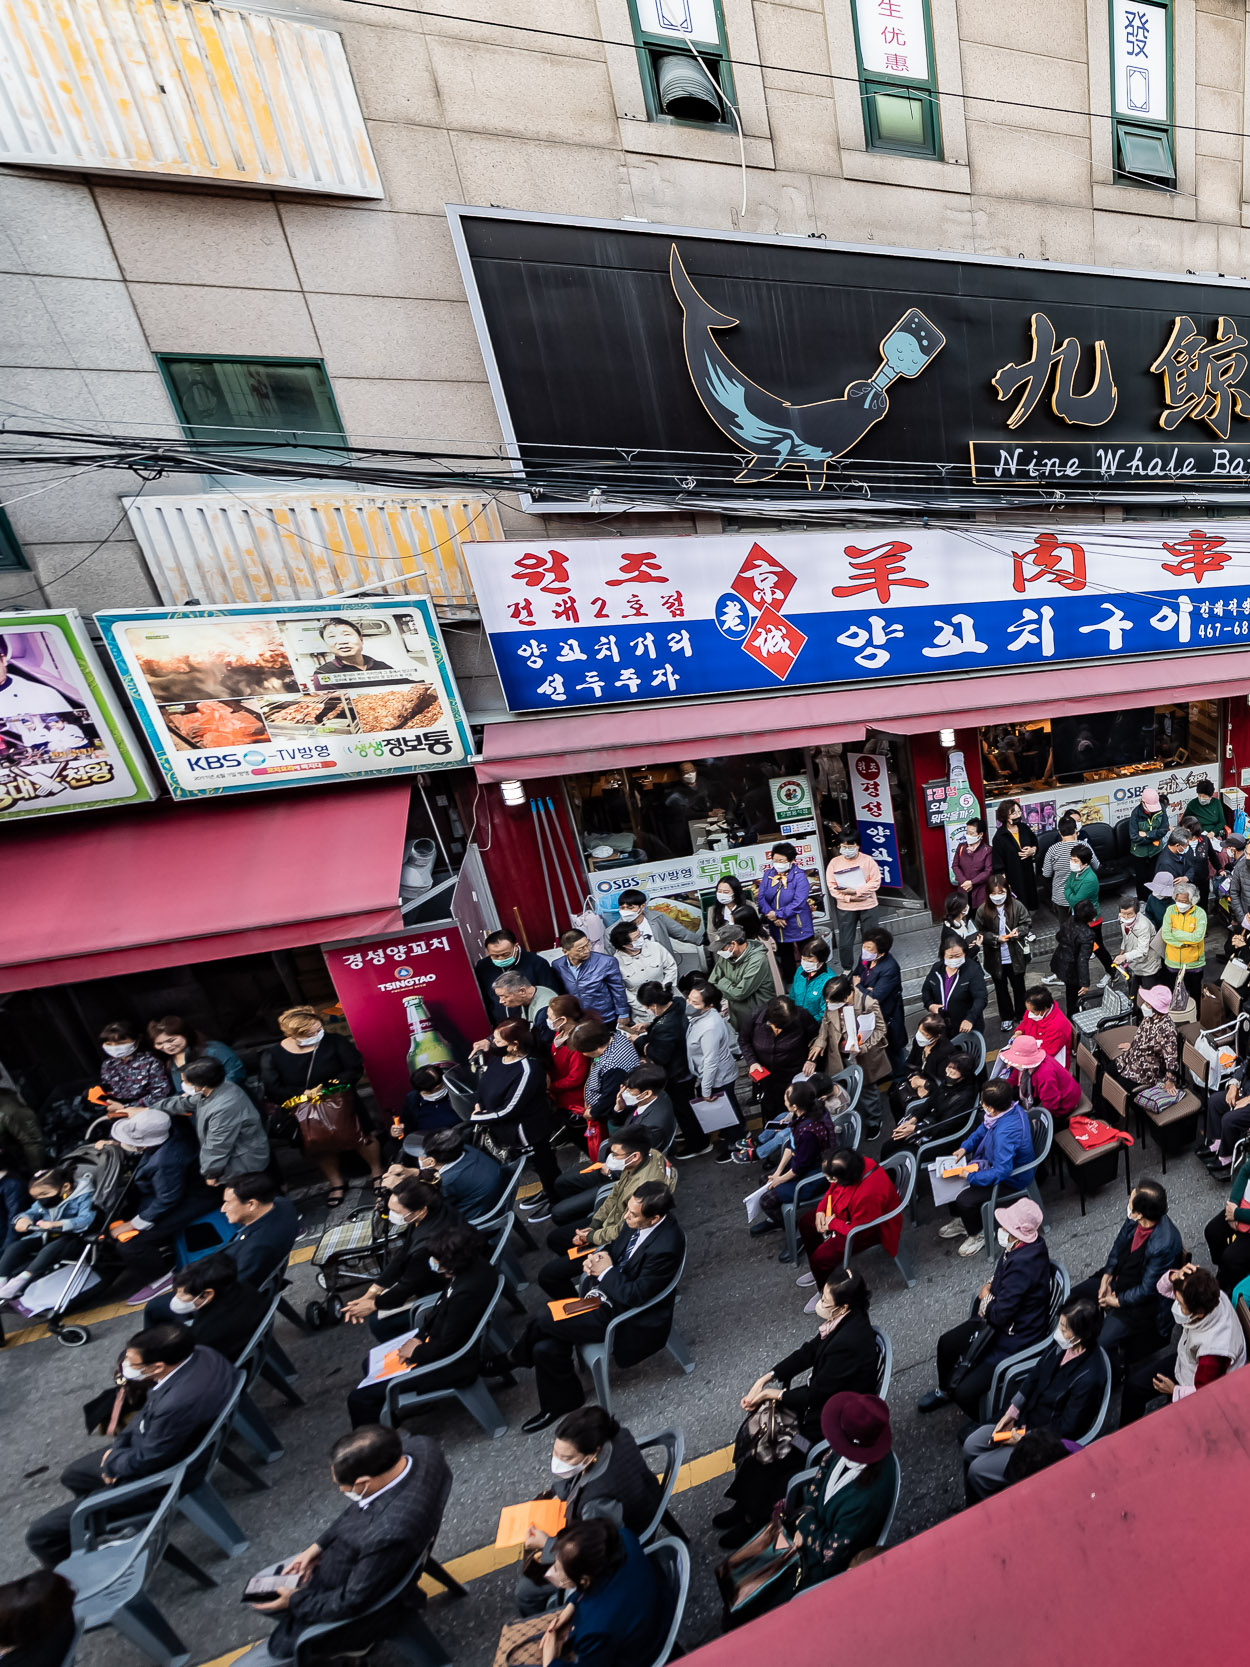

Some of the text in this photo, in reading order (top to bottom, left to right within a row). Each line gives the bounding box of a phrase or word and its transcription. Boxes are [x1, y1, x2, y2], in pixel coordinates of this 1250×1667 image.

[994, 447, 1082, 478] Nine
[1096, 447, 1198, 477] Whale
[511, 548, 670, 594] 원조
[831, 529, 1233, 604] 羊肉串
[517, 628, 693, 670] 양꼬치거리
[836, 595, 1191, 669] 양꼬치구이
[536, 662, 681, 702] 선두주자
[354, 729, 454, 758] 생생정보통
[186, 753, 242, 772] KBS
[857, 761, 878, 773] 원조
[861, 780, 882, 818] 경성
[929, 801, 949, 812] 오늘
[342, 935, 451, 970] 경성양꼬치
[377, 973, 436, 993] TSINGTAO
